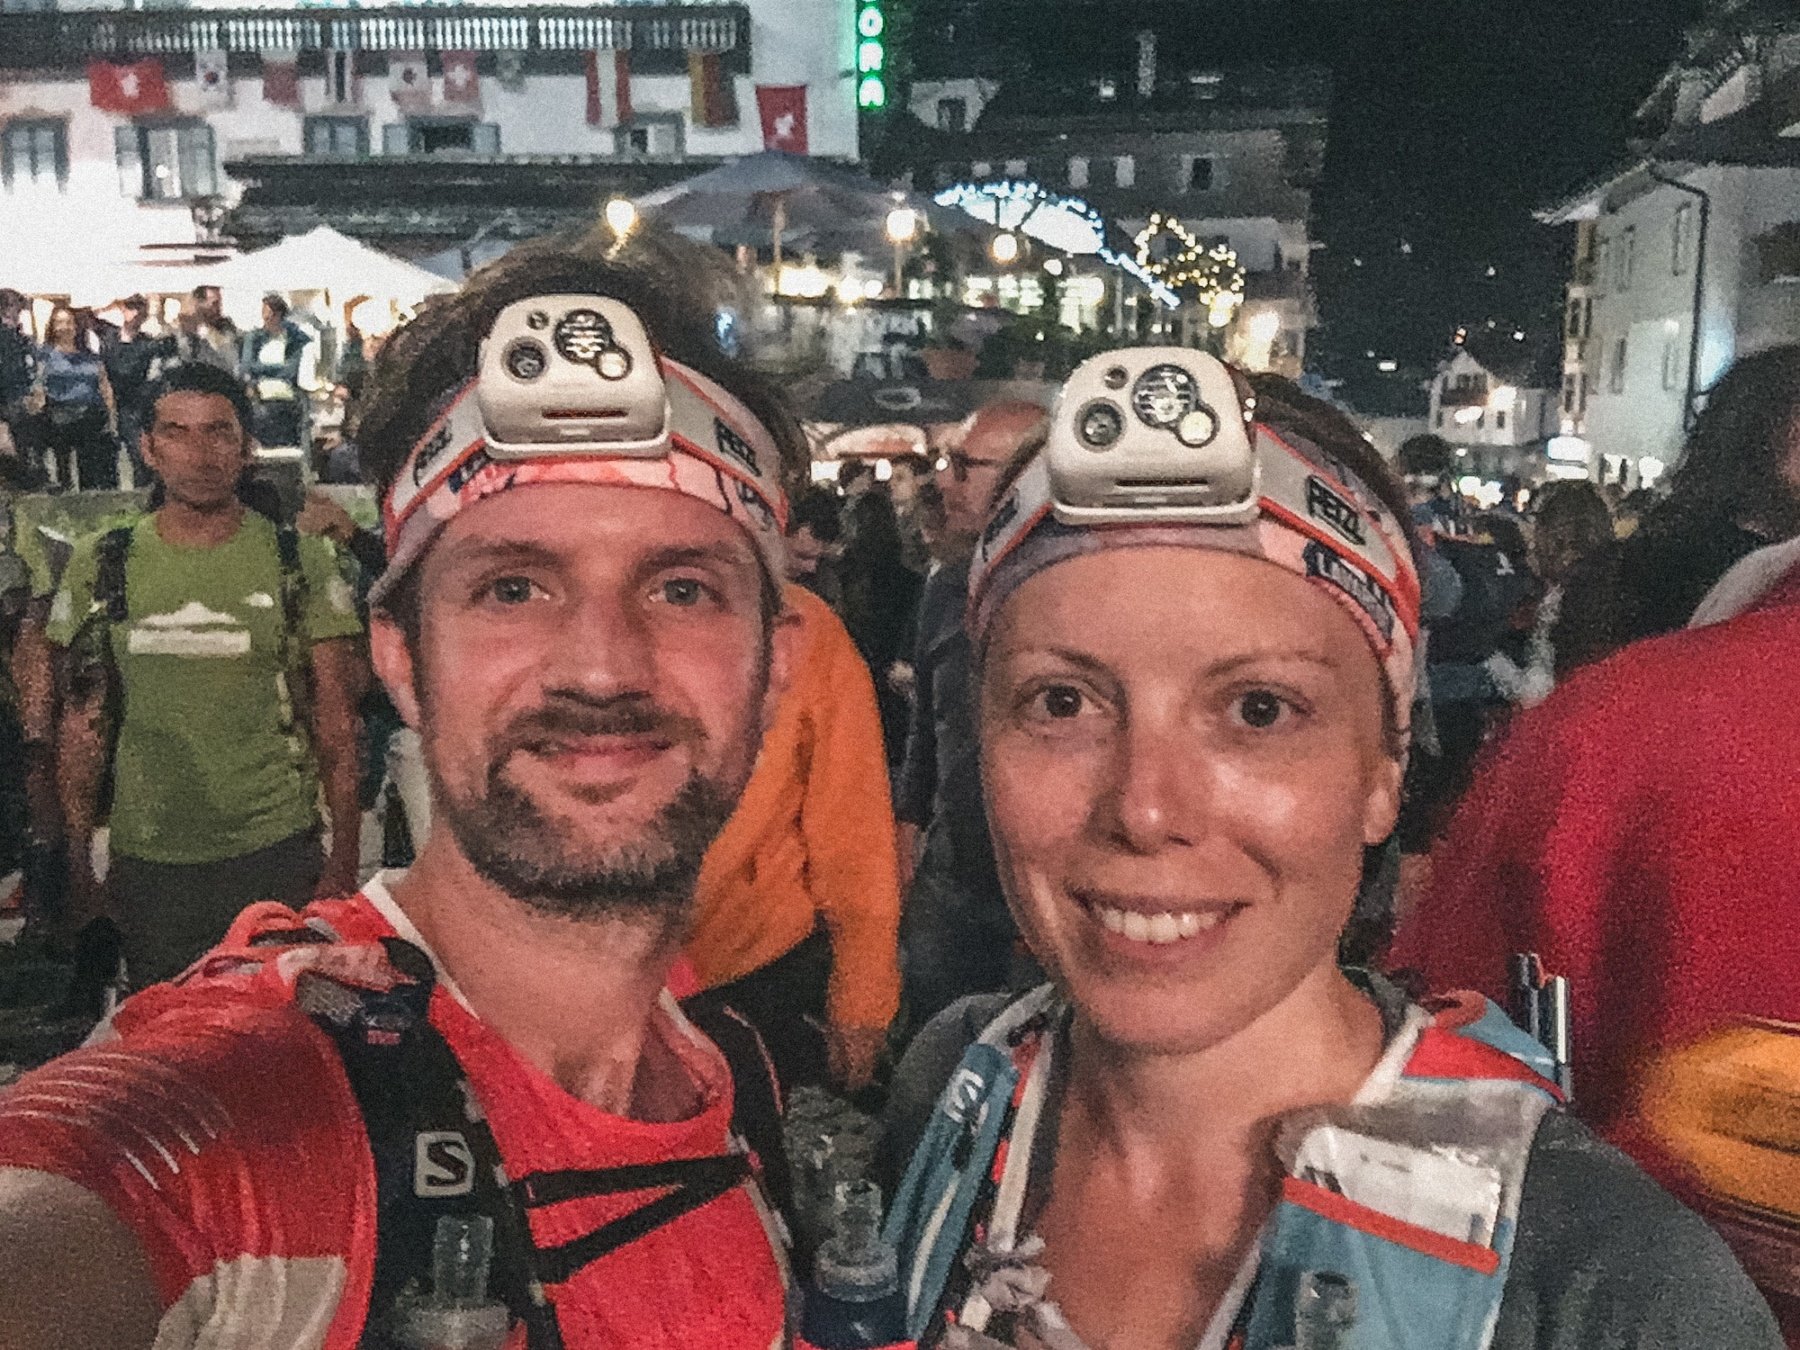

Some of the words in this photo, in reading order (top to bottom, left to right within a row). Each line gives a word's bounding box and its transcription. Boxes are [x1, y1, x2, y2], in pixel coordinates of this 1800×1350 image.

[858, 0, 885, 106] ORA
[1307, 475, 1366, 545] PETZL
[423, 1138, 471, 1190] S
